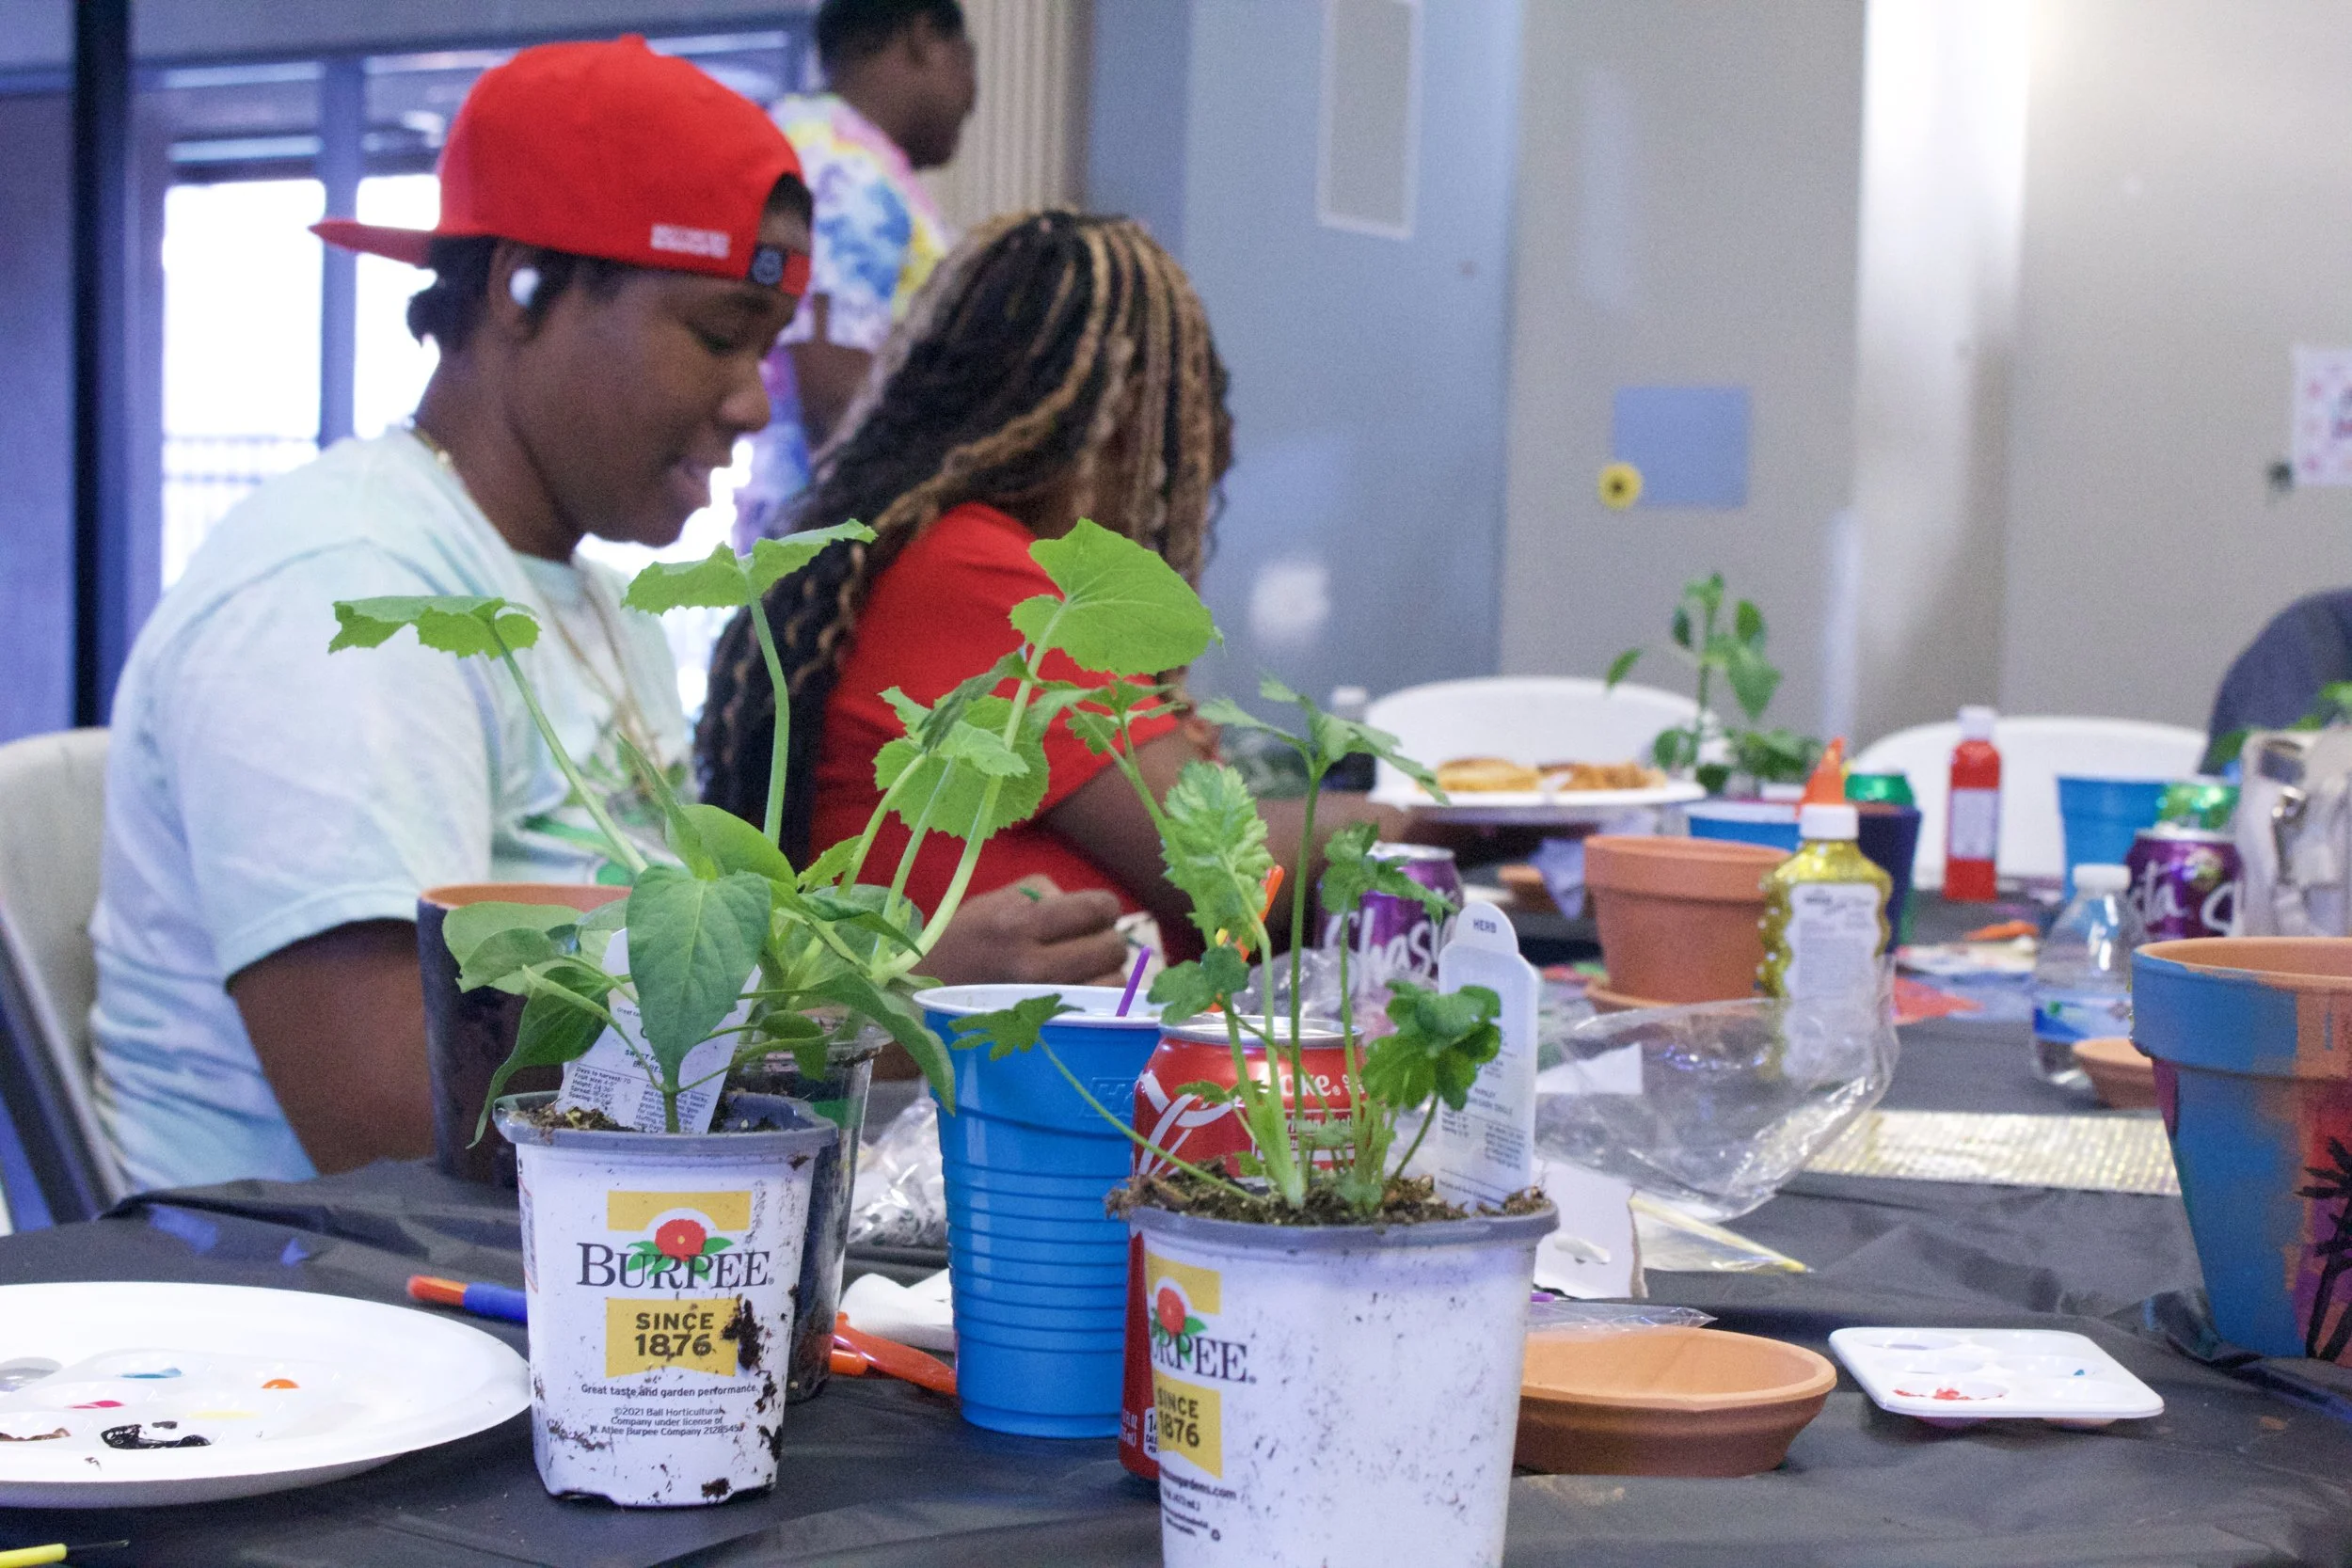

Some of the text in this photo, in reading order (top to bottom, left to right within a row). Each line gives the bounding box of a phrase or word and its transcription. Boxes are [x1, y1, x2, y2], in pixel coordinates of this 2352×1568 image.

[1473, 918, 1497, 933] HERB
[635, 1312, 715, 1330] SINCE
[634, 1333, 712, 1356] 1876
[581, 1384, 607, 1395] Great
[610, 1386, 637, 1397] taste
[639, 1386, 658, 1397] and
[660, 1387, 695, 1399] garden
[646, 1407, 663, 1417] Ball
[611, 1416, 723, 1427] Company under license of
[627, 1427, 660, 1436] Burpee
[660, 1427, 702, 1437] Company
